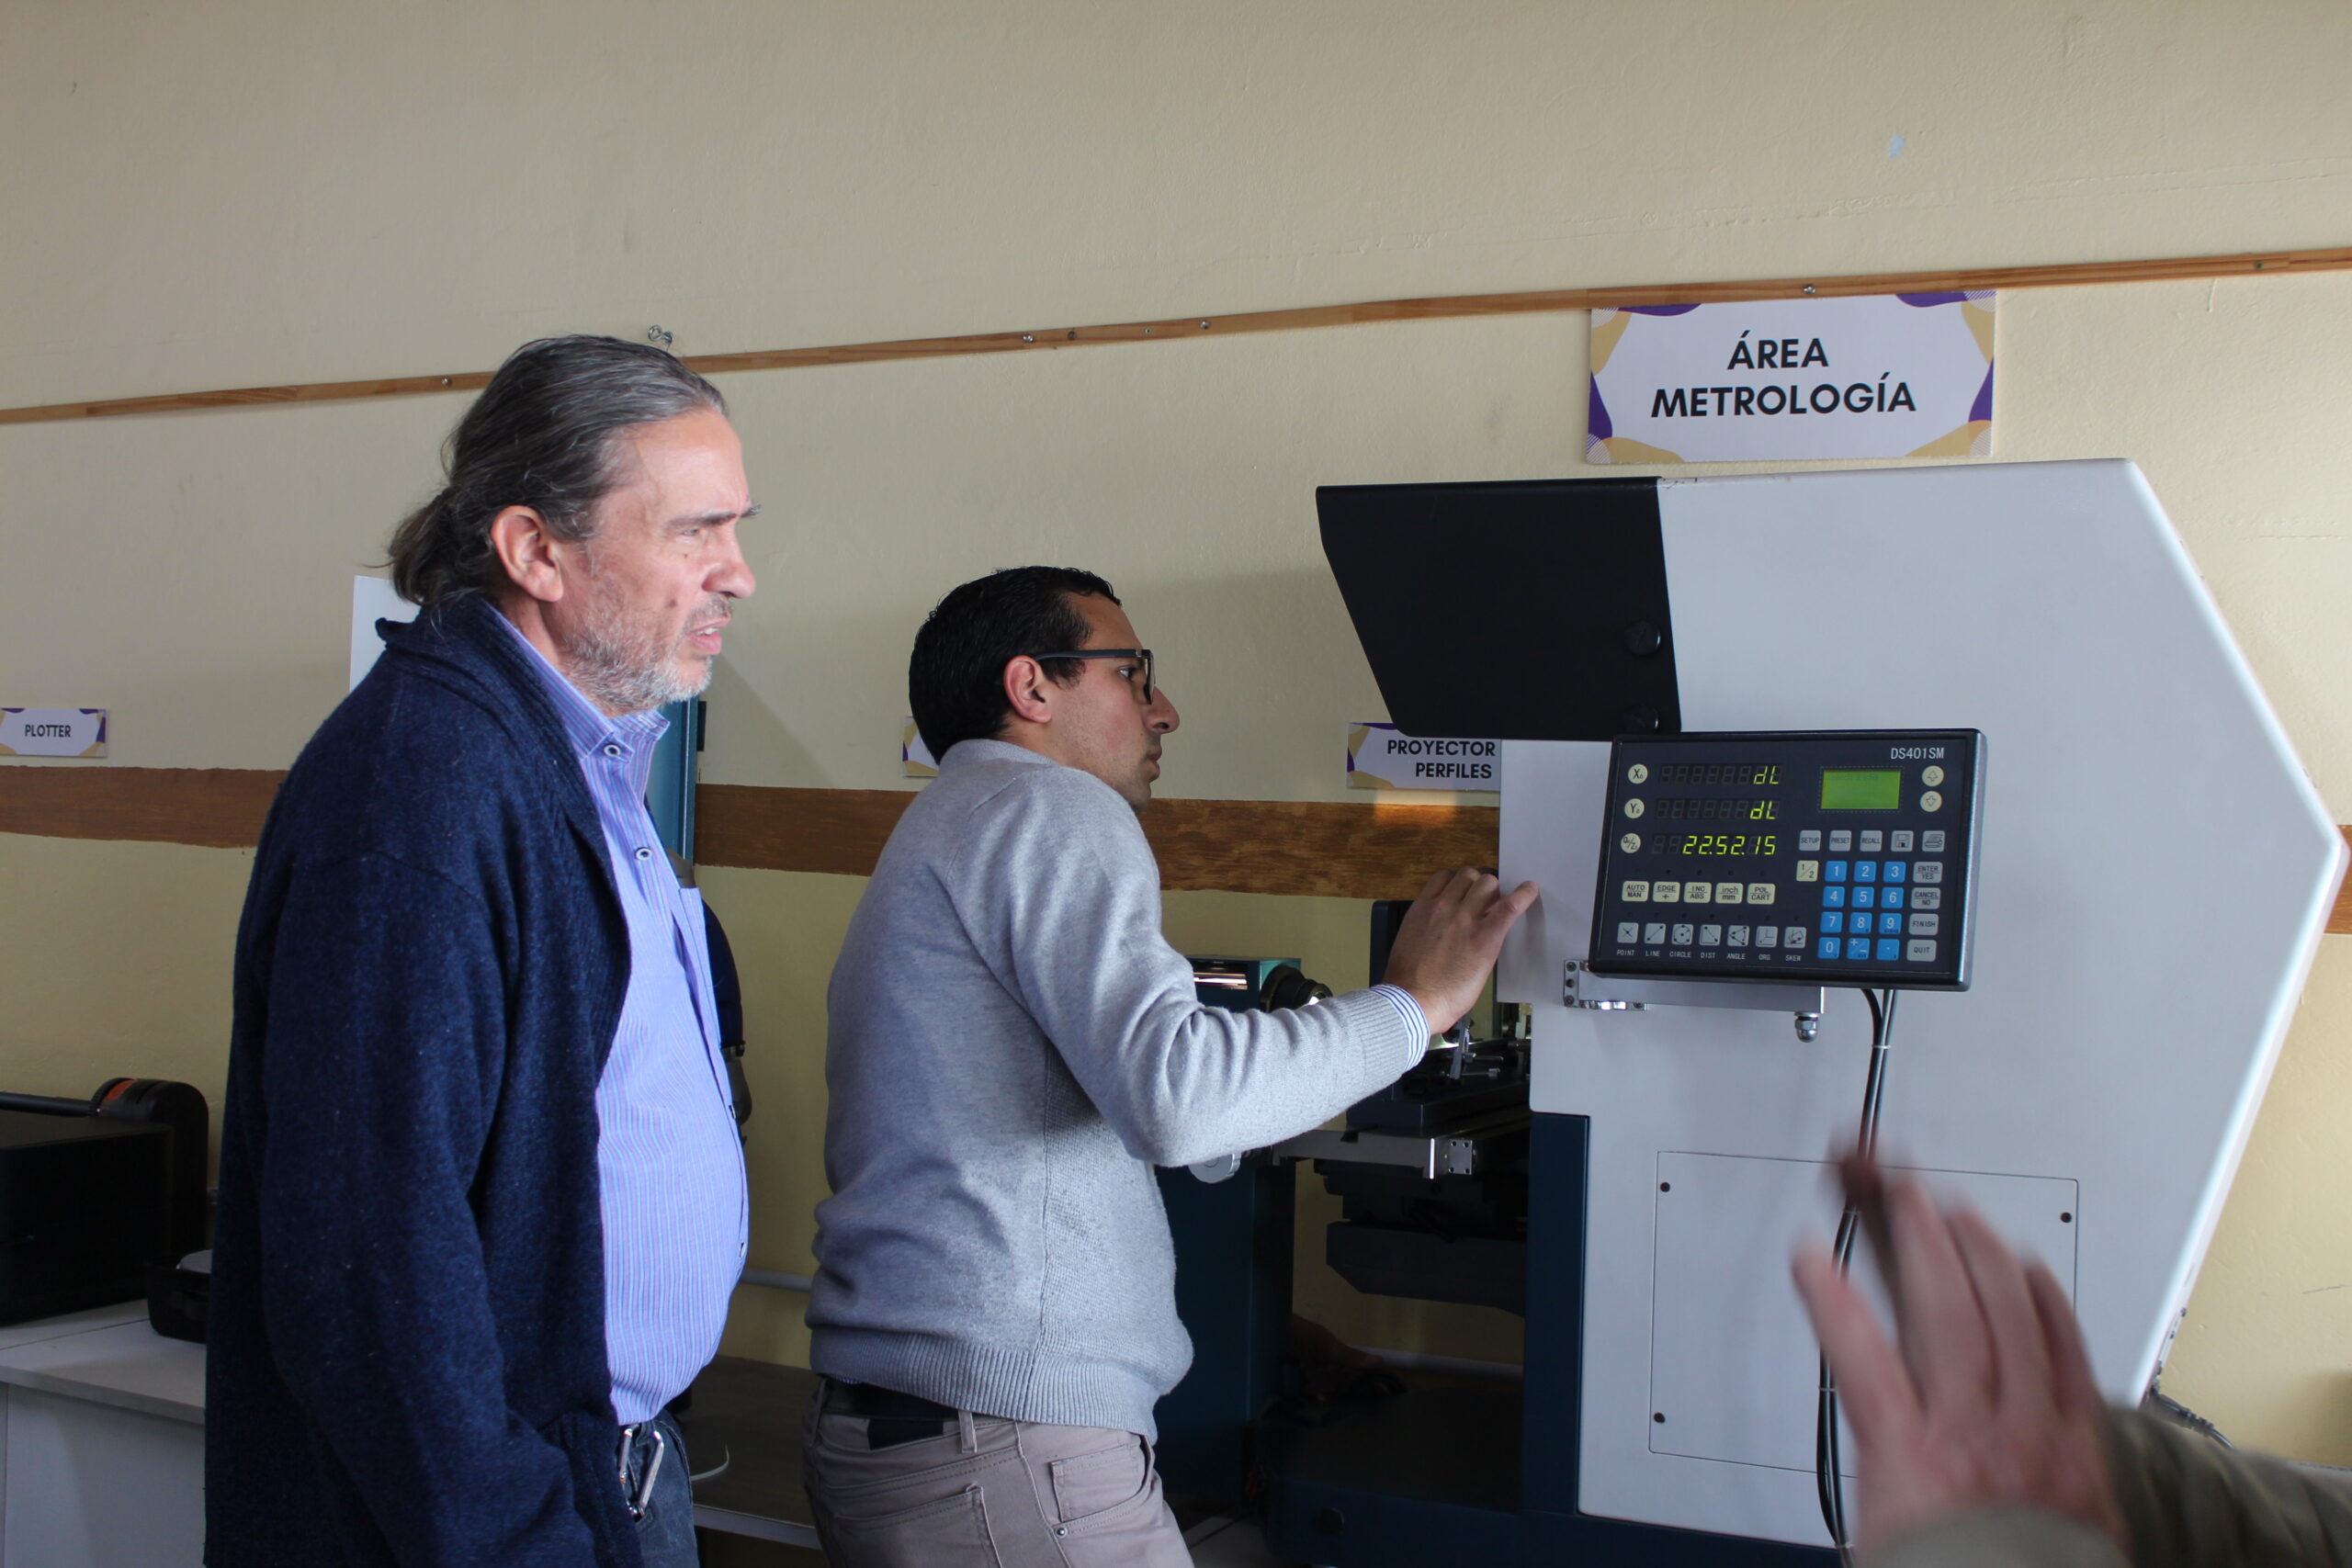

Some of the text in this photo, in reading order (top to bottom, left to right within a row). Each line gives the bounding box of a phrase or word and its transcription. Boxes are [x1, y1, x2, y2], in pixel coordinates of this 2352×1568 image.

[1727, 330, 1829, 369] ÁREA
[1651, 371, 1917, 418] METROLOGÍA
[24, 724, 72, 738] PLOTTER
[1386, 739, 1496, 756] PROYECTOR
[1890, 747, 1945, 760] DS401SM
[1415, 762, 1492, 779] PERFILES
[1834, 866, 1839, 877] 1
[1861, 865, 1870, 877] 2
[1891, 866, 1900, 878] 3
[1626, 884, 1645, 892] AUTO
[1722, 886, 1739, 894] inch
[1829, 890, 1838, 902] 4
[1859, 891, 1868, 903] 5
[1889, 891, 1897, 903] 6
[1829, 916, 1837, 928] 7
[1857, 917, 1866, 929] 8
[1886, 918, 1894, 930] 9
[1826, 942, 1834, 953] 0
